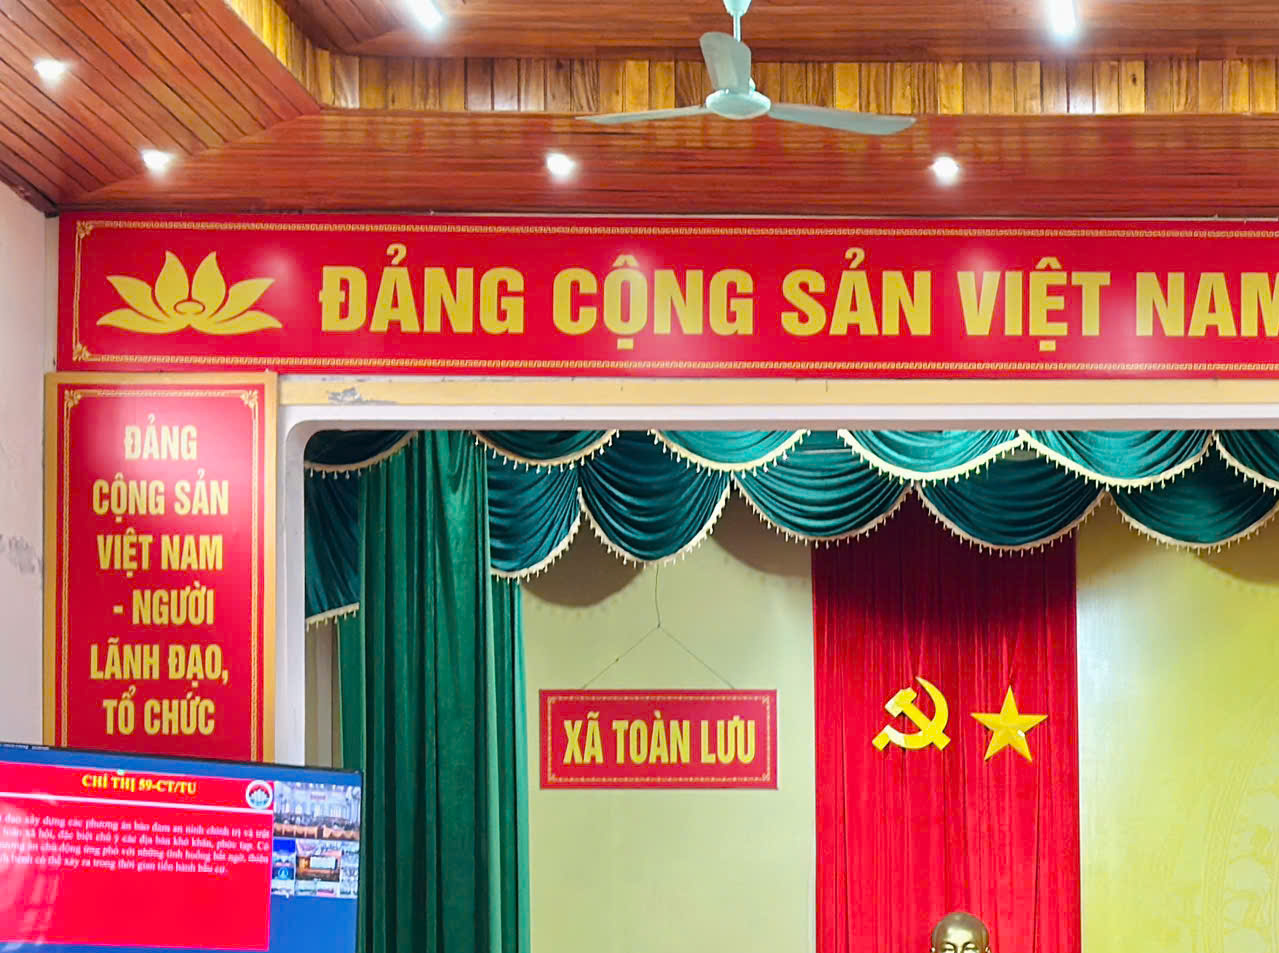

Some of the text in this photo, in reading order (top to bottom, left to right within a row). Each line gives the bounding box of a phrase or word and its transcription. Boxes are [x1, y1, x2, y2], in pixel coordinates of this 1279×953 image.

[319, 243, 524, 336] ĐẢNG
[552, 255, 754, 350] CỘNG
[780, 247, 932, 337] SẢN
[957, 257, 1111, 351] VIỆT
[124, 413, 197, 461] ĐẢNG
[92, 468, 229, 523] CỘNG SẢN
[96, 528, 223, 578] VIỆT NAM
[112, 581, 215, 625] - NGƯỜI
[89, 637, 230, 688] LÃNH ĐẠO,
[102, 684, 216, 736] TỔ CHỨC
[562, 710, 756, 765] XÃ TOÀN LƯU
